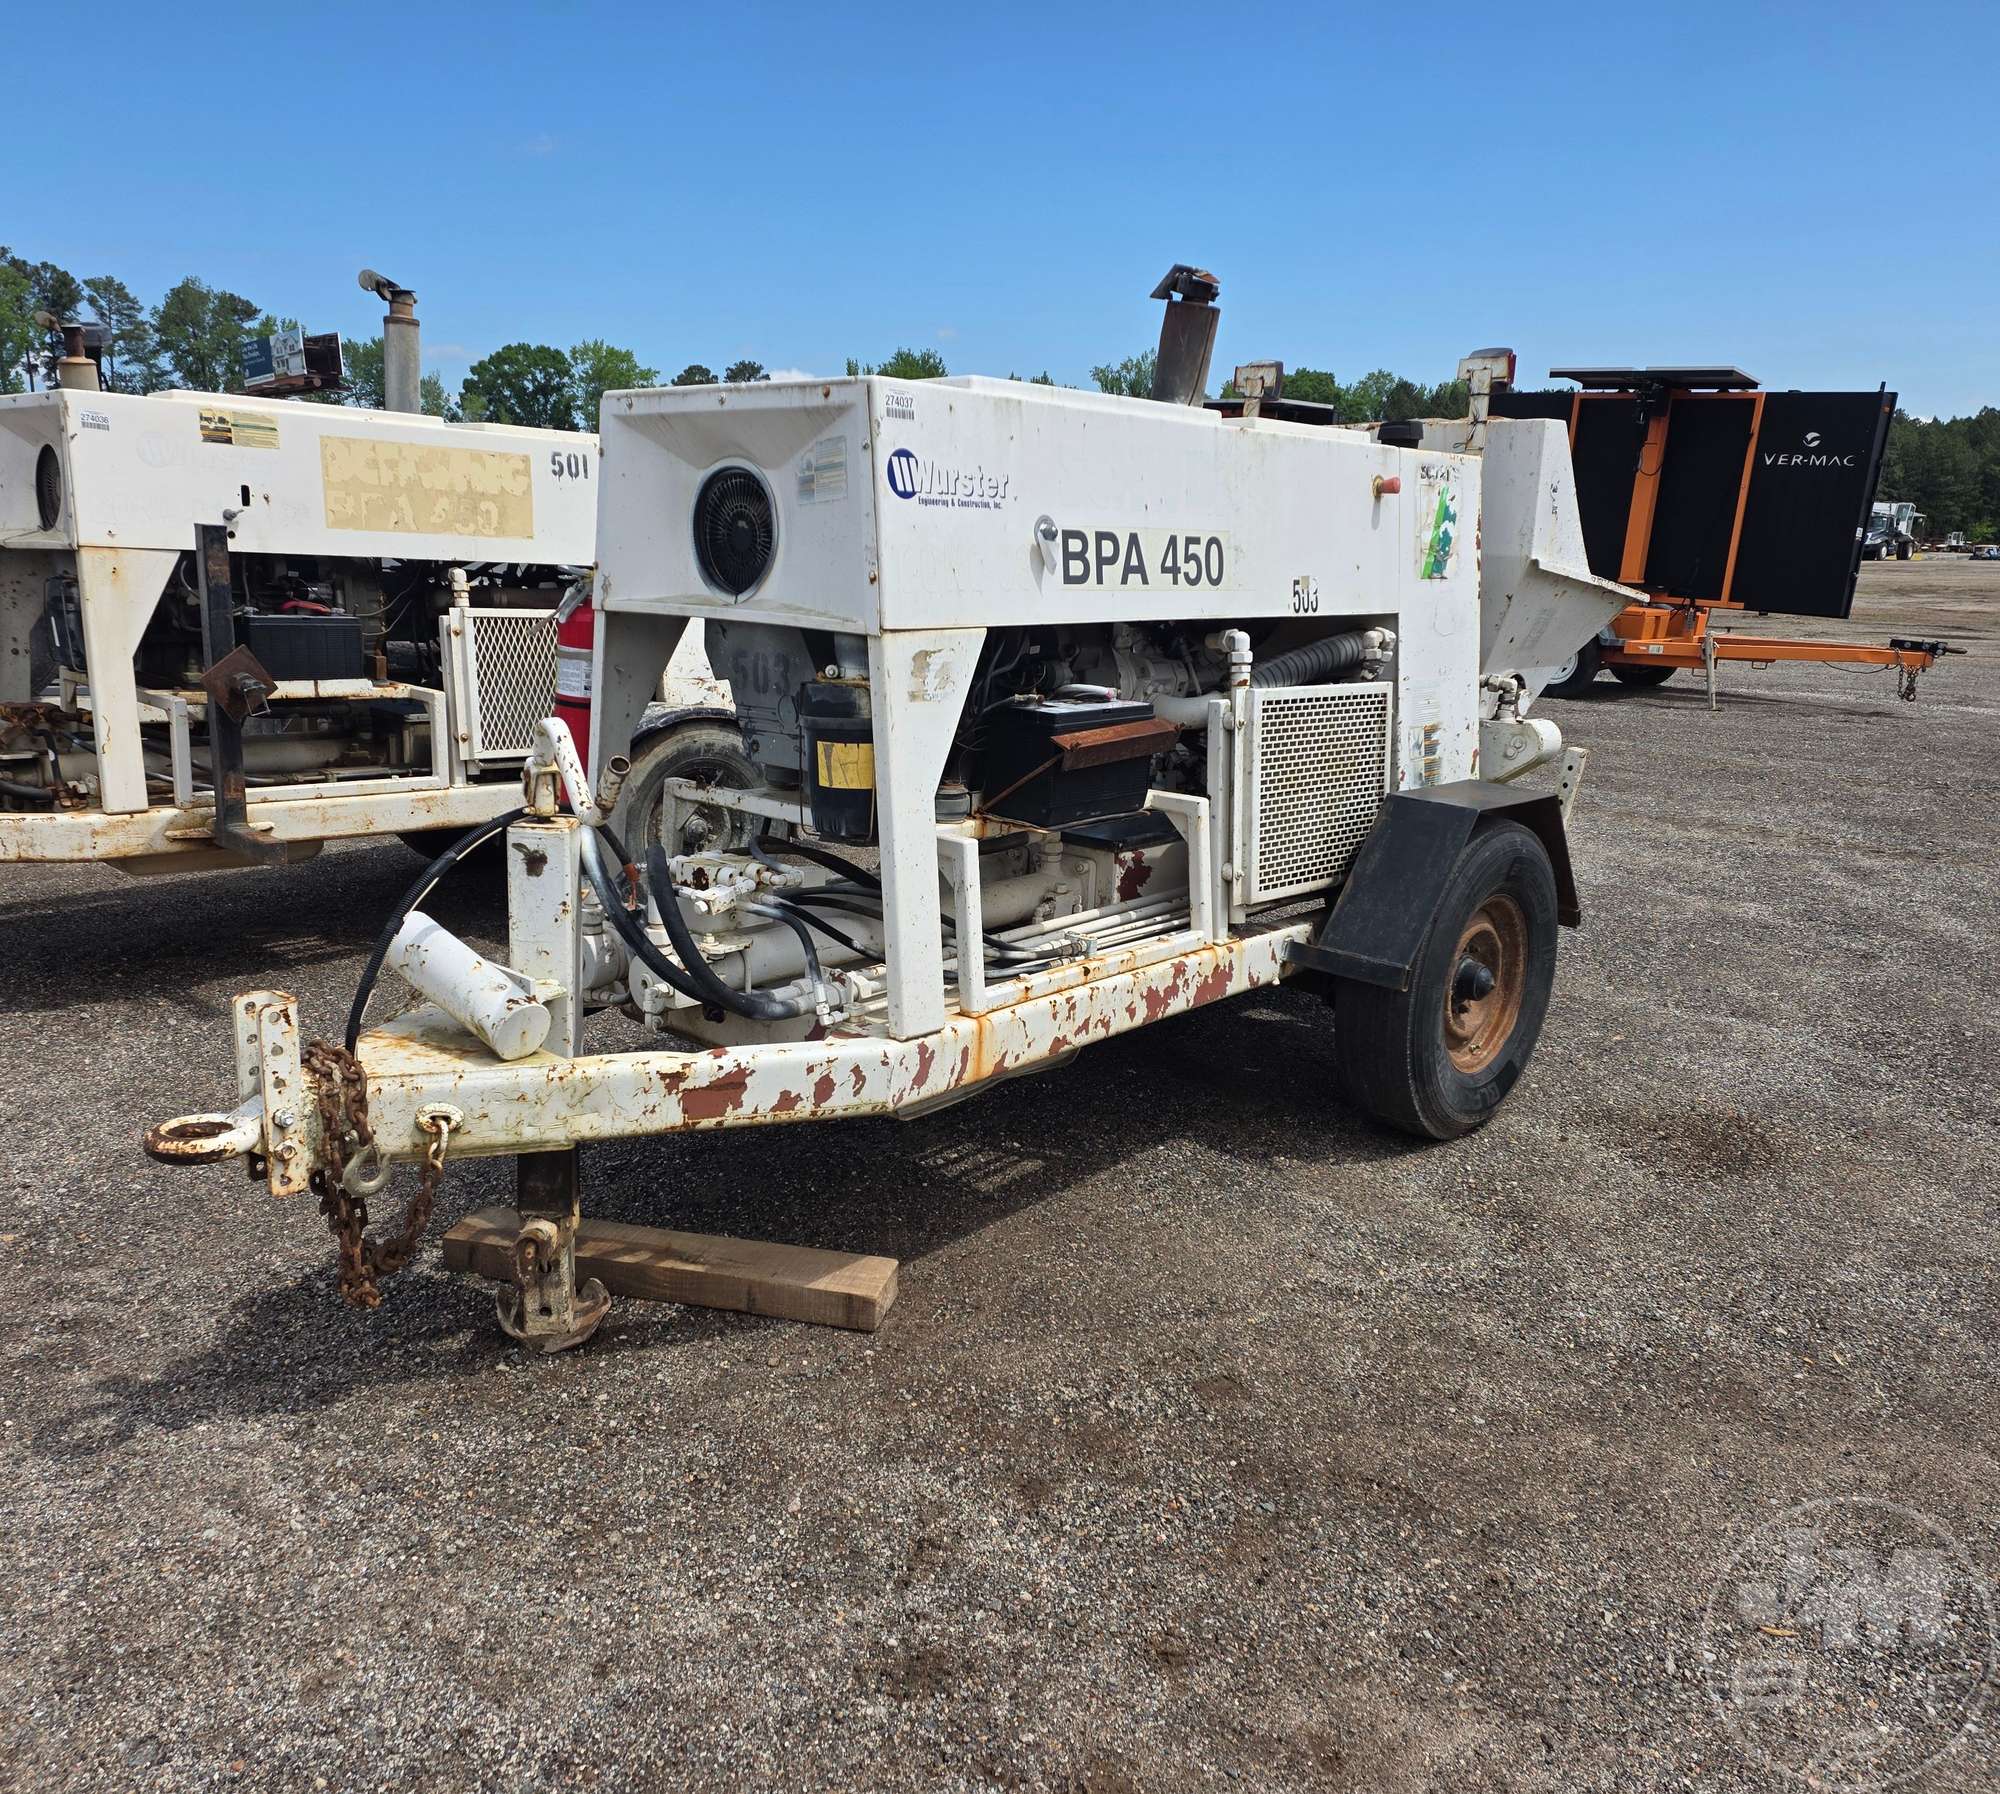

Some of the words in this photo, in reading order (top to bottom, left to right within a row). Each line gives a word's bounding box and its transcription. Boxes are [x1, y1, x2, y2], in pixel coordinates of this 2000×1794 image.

[885, 394, 914, 409] 274037
[80, 412, 110, 425] 274036
[551, 451, 589, 481] 501
[1764, 451, 1856, 467] VER-MAC
[914, 459, 1010, 500] Wurster
[918, 497, 949, 508] Engineering
[1061, 529, 1150, 586] BPA
[1160, 534, 1225, 587] 450
